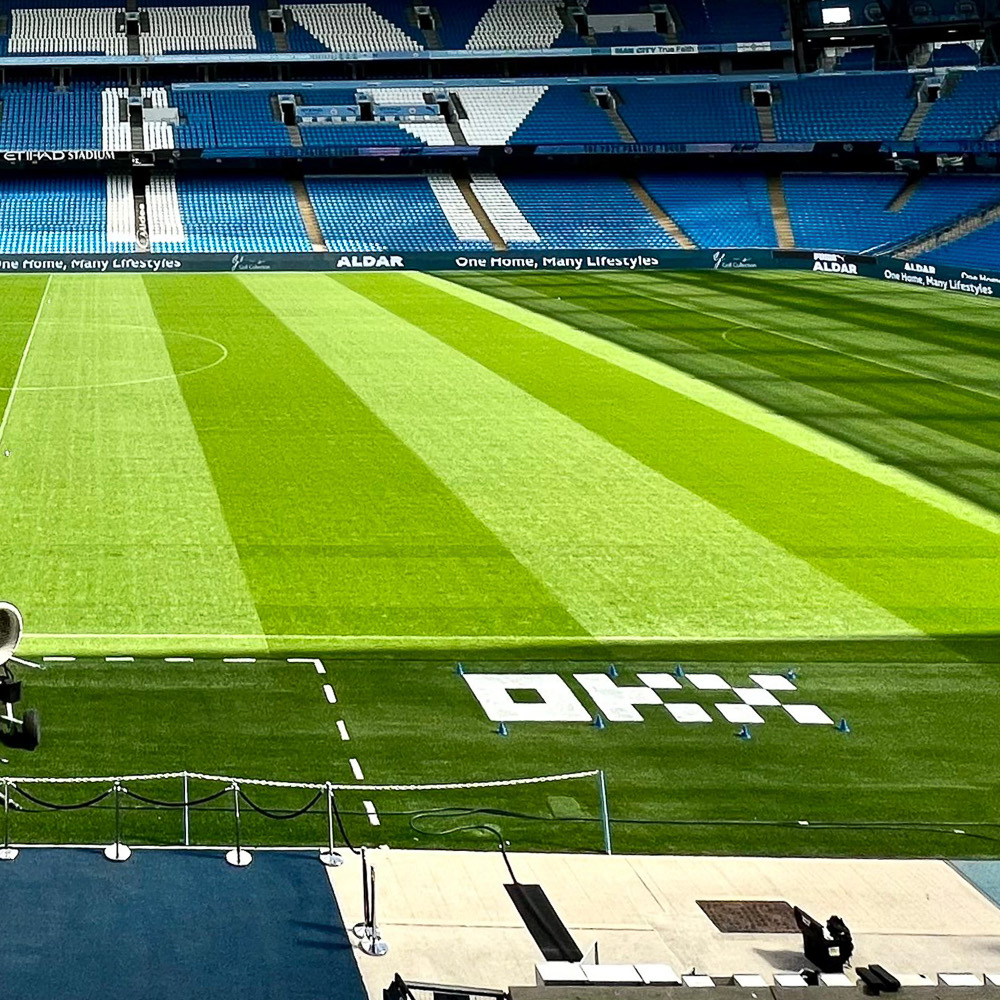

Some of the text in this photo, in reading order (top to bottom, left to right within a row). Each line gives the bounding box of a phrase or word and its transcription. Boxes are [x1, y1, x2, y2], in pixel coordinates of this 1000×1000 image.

[636, 46, 656, 54] CITY
[676, 45, 695, 53] Faith
[3, 150, 116, 161] ETIHAD STADIUM
[22, 259, 67, 271] Home,
[71, 259, 109, 272] Many
[337, 255, 659, 270] ALDAR One Home, Many Lifestyles
[812, 261, 858, 275] ALDAR
[904, 263, 936, 275] ALDAR
[884, 269, 994, 296] One Home, Many Lifestyles
[461, 673, 835, 725] OKX
